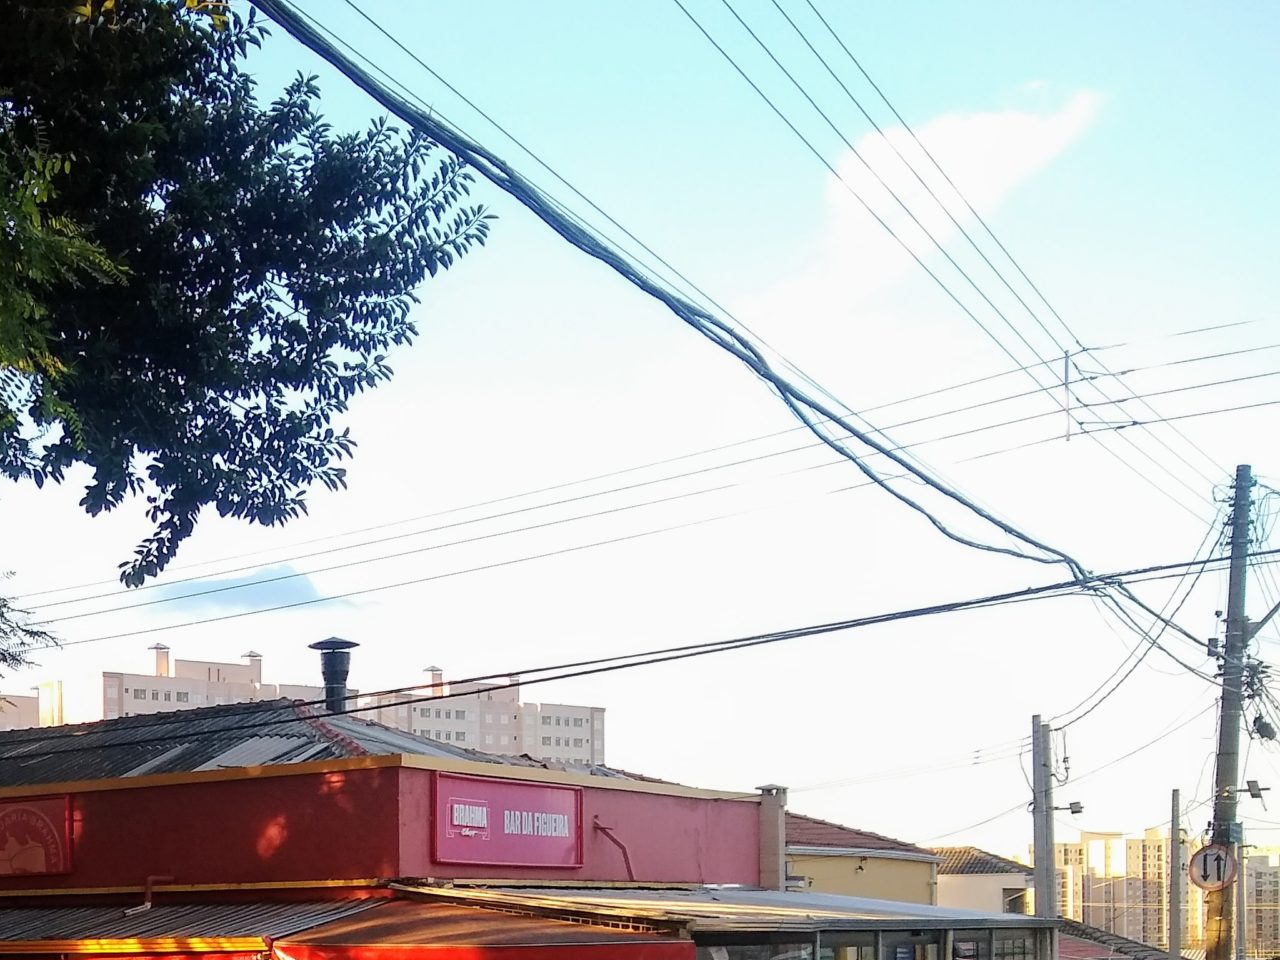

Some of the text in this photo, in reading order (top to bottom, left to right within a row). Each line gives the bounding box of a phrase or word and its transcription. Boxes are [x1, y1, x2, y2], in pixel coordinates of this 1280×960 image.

[453, 804, 488, 828] BRAHMA
[504, 810, 569, 838] BAR DA FIGUEIRA
